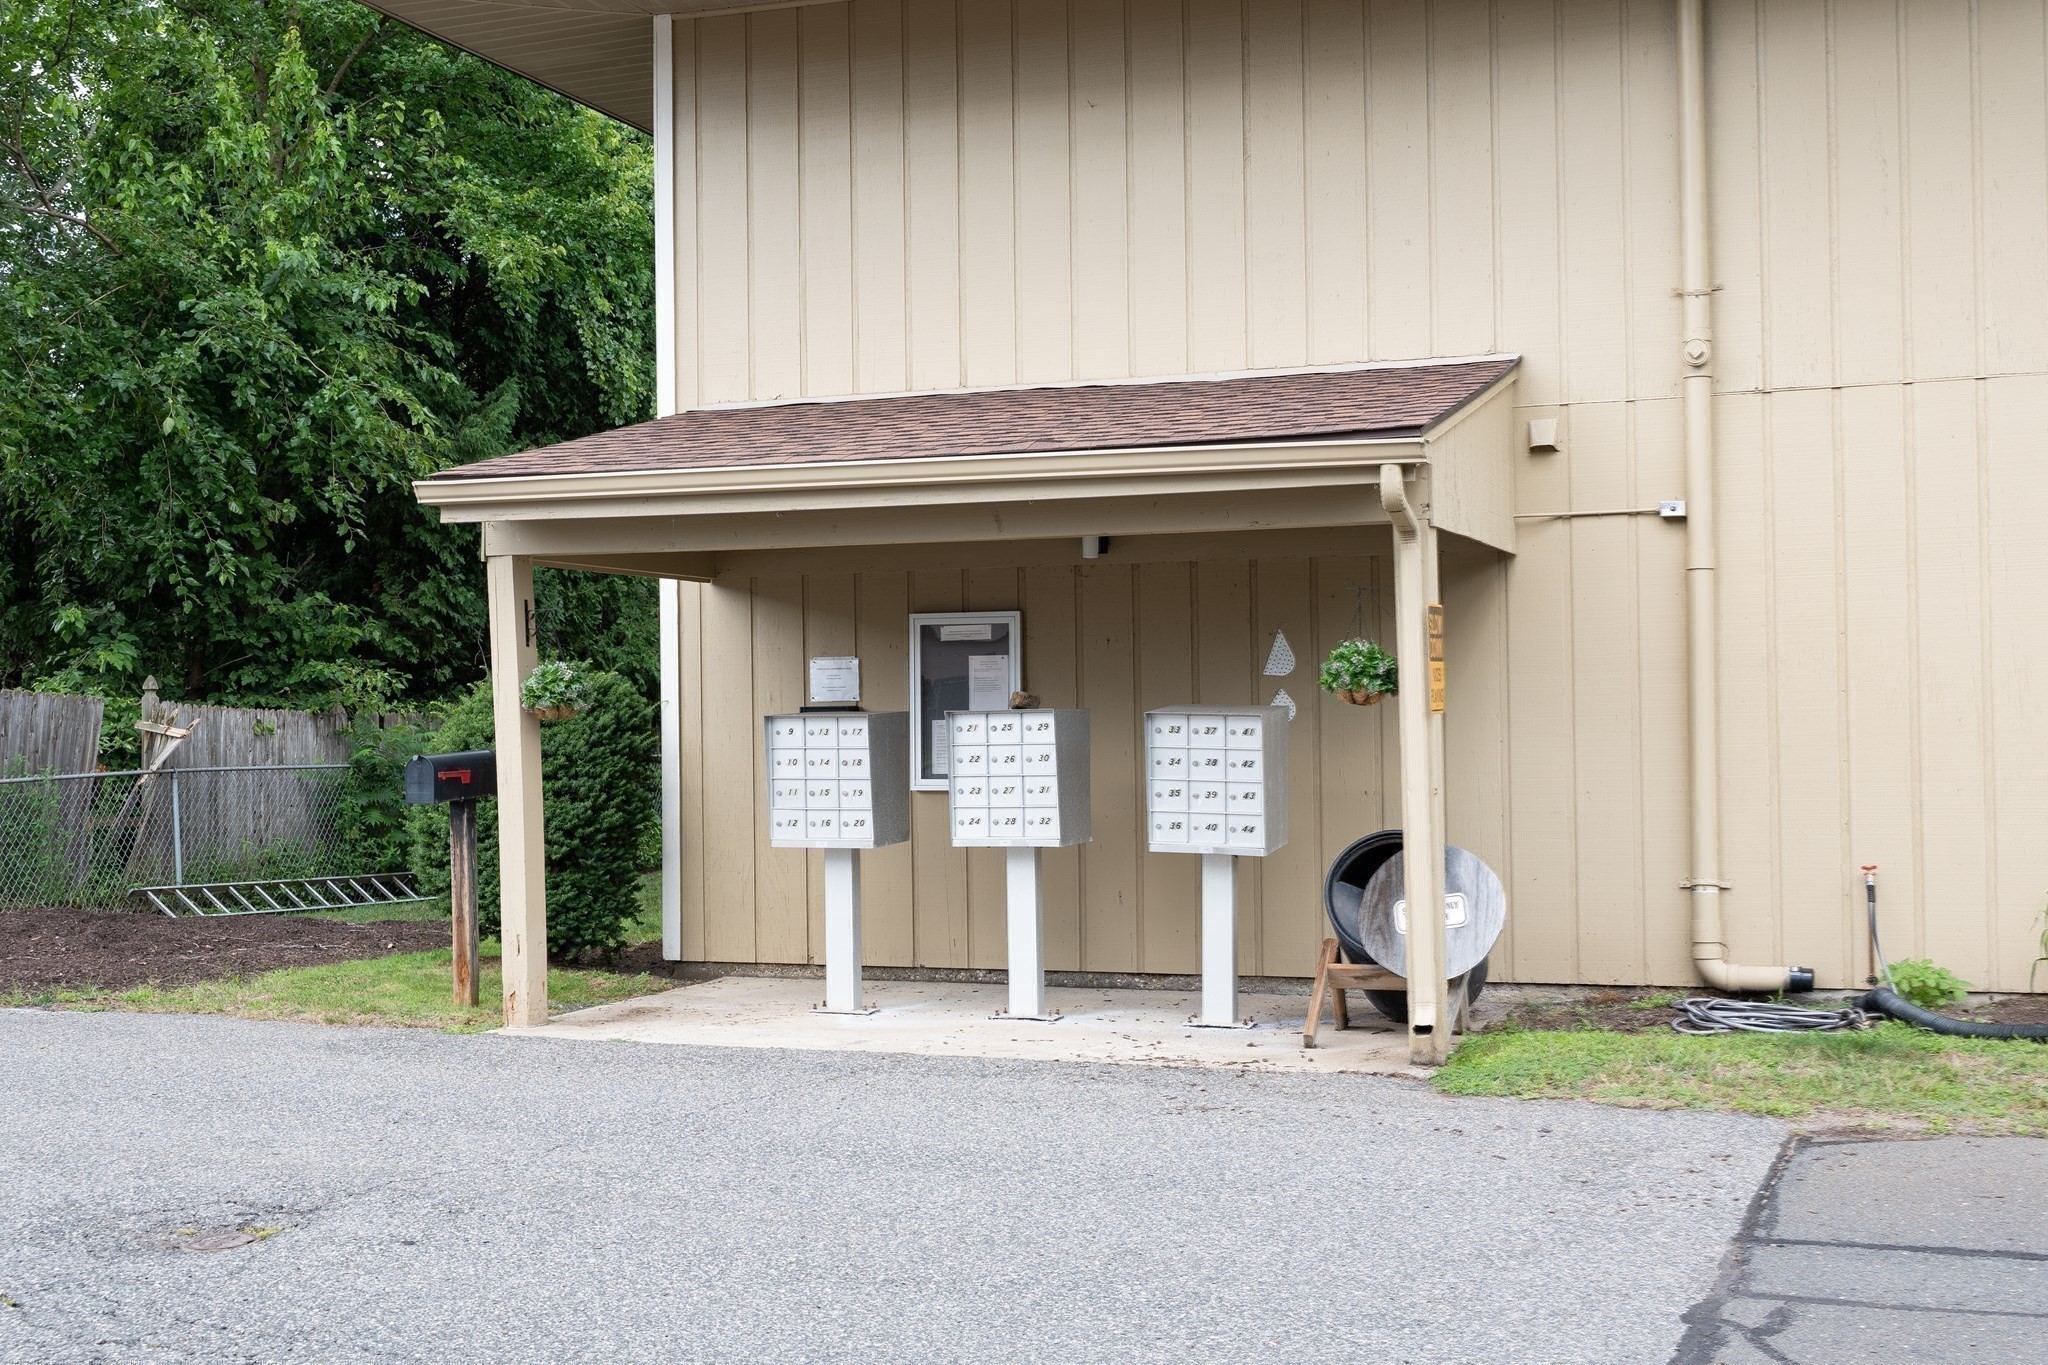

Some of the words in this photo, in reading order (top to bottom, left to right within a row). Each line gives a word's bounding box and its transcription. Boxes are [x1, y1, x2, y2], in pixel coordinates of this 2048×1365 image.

[966, 724, 977, 732] 21
[1001, 723, 1013, 731] 25
[1037, 723, 1049, 731] 29
[1168, 725, 1181, 734] 33
[1204, 727, 1217, 735] 37
[788, 728, 794, 736] 9
[818, 728, 829, 736] 13
[851, 728, 863, 736] 17
[1242, 728, 1255, 736] 41
[787, 758, 798, 766] 10
[968, 755, 980, 763] 22
[1038, 754, 1050, 762] 30
[1168, 758, 1181, 766] 34
[1205, 759, 1218, 767] 38
[1241, 760, 1254, 768] 42
[788, 788, 798, 796] 11
[820, 788, 830, 796] 15
[852, 789, 863, 797] 19
[969, 787, 981, 795] 23
[1003, 786, 1015, 794] 27
[1039, 786, 1050, 794] 31
[1168, 789, 1181, 797] 35
[1205, 791, 1218, 799] 39
[1242, 792, 1256, 800] 43
[787, 819, 798, 827] 12
[821, 819, 831, 827] 16
[853, 819, 865, 827] 20
[969, 817, 981, 825] 24
[1004, 817, 1016, 825] 28
[1039, 817, 1051, 825] 32
[1169, 822, 1182, 830] 36
[1205, 823, 1217, 832] 40
[1241, 826, 1255, 834] 44
